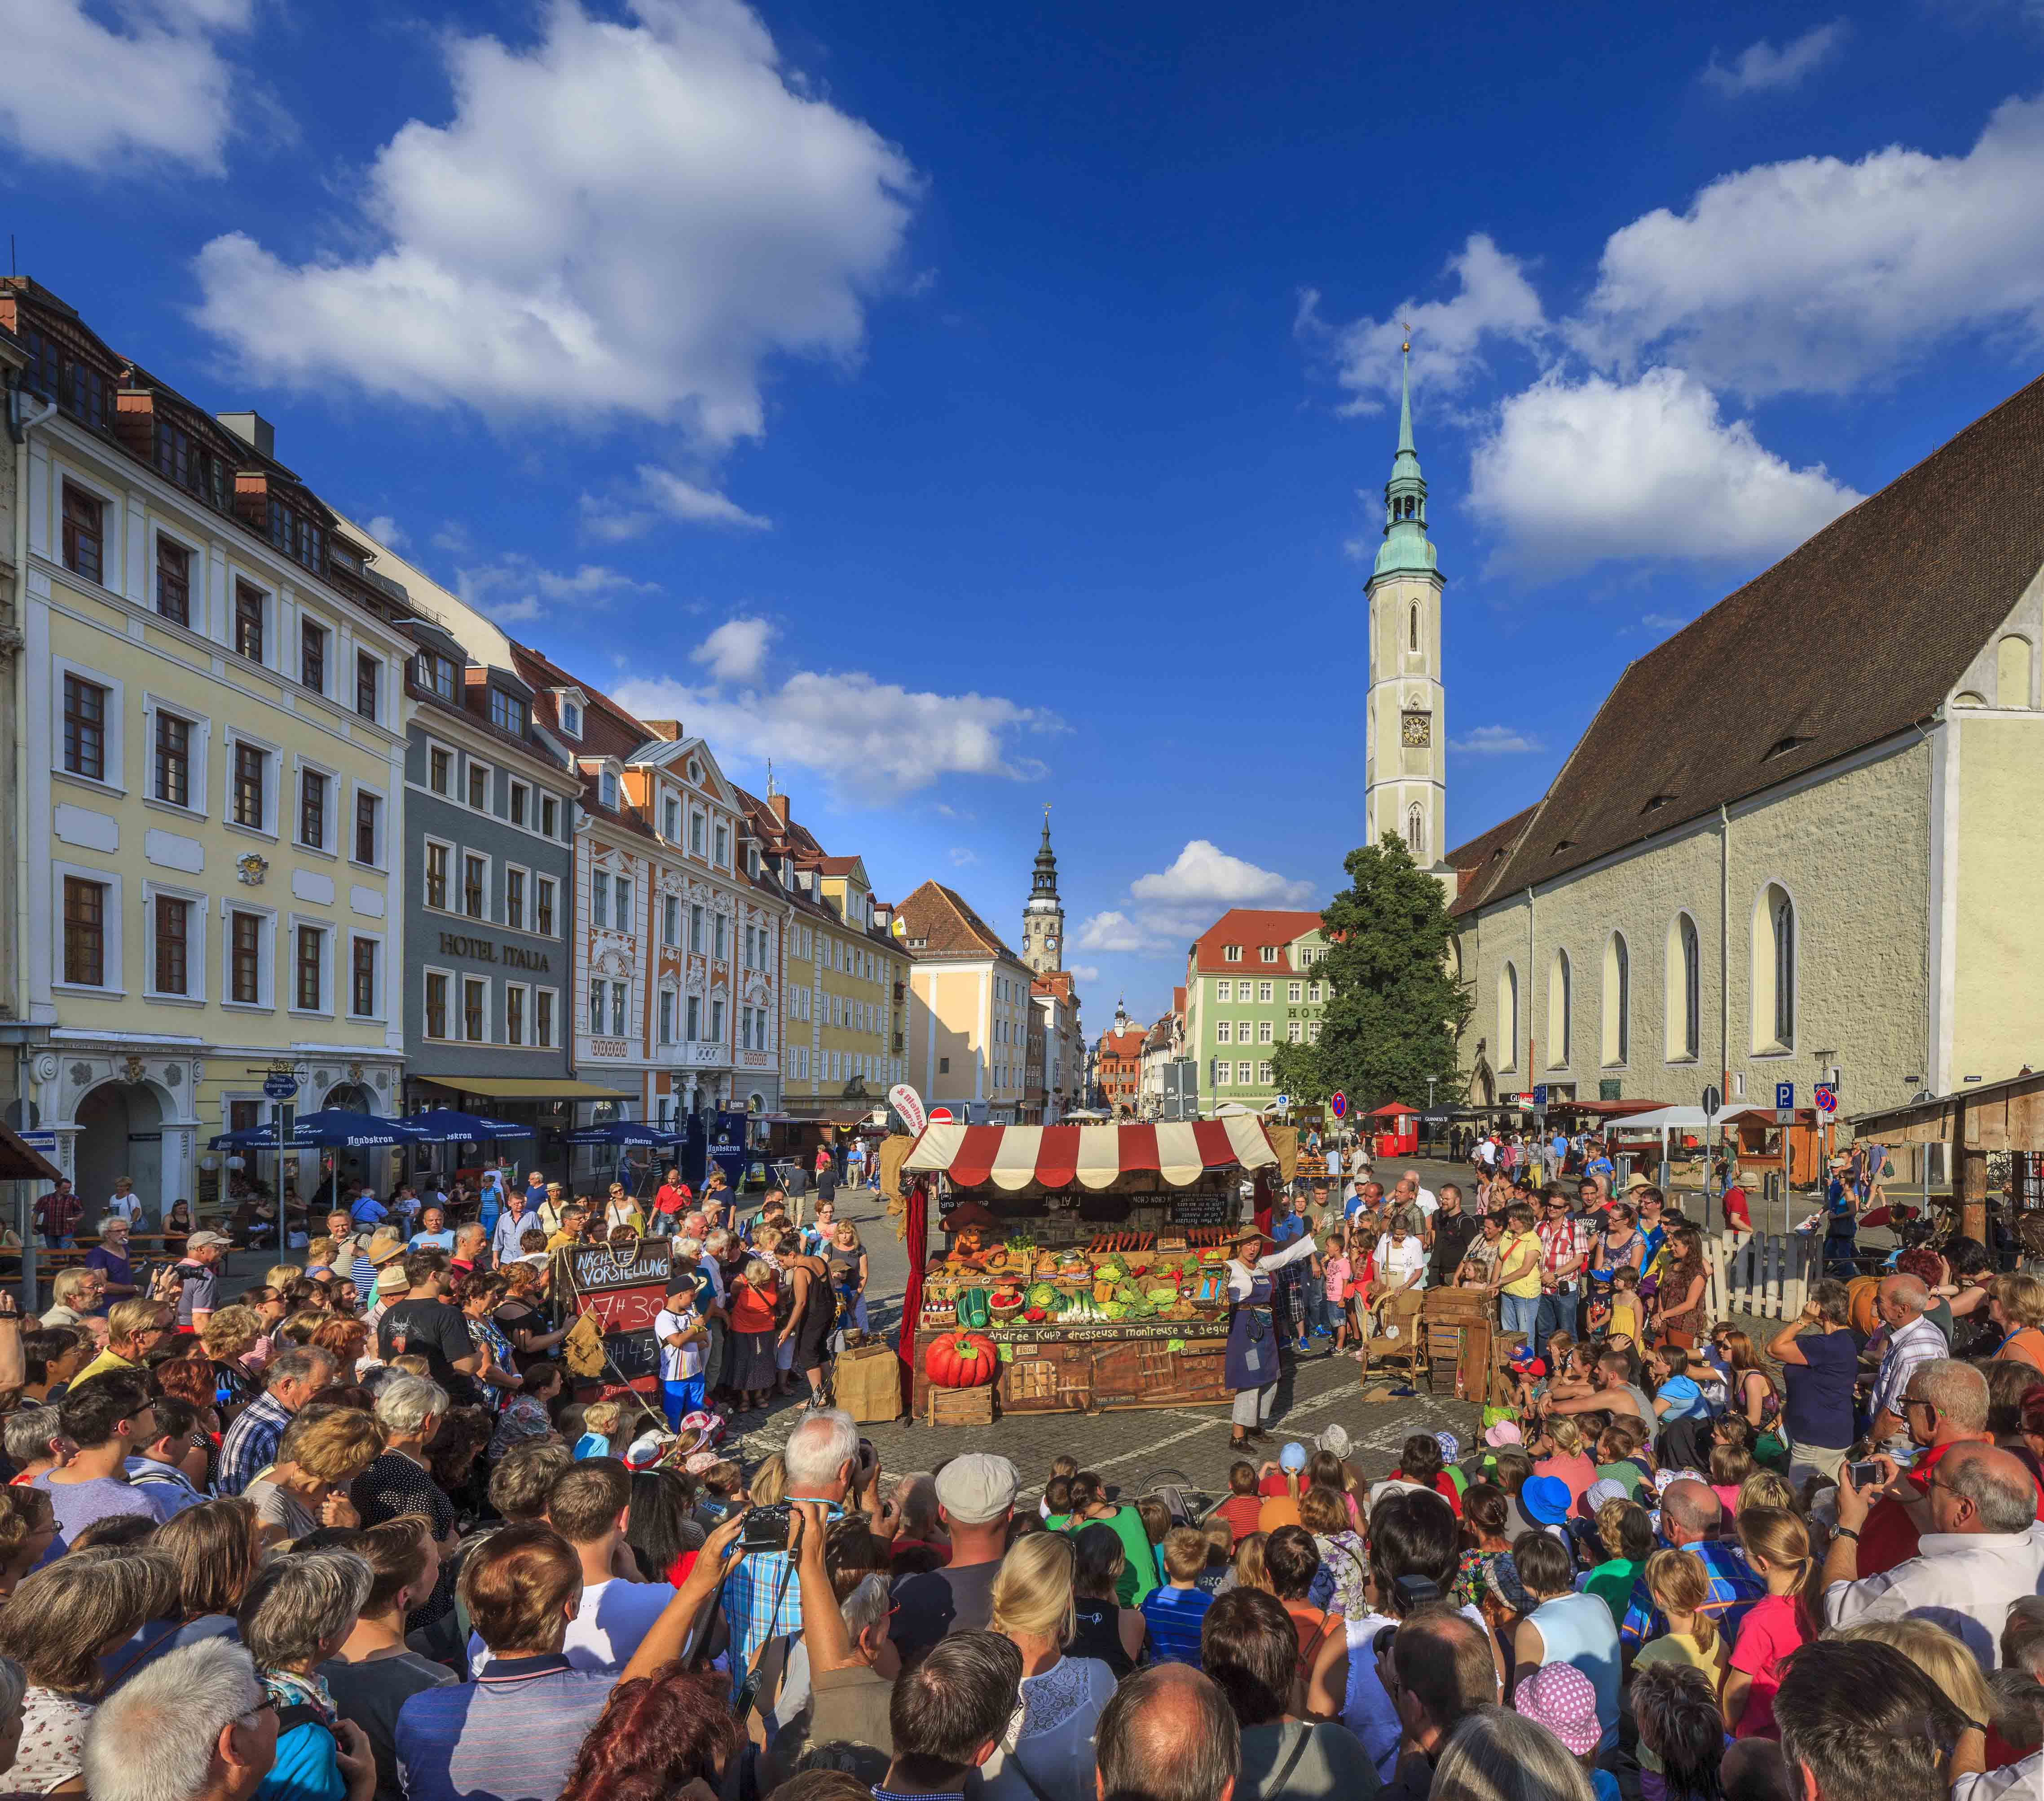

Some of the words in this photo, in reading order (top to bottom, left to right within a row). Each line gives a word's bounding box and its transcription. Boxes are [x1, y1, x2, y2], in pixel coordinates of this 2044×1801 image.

[439, 931, 497, 962] HOTEL
[503, 945, 550, 972] ITALIA
[1287, 1008, 1321, 1018] HOT
[1511, 1094, 1520, 1102] GU
[1780, 1086, 1789, 1105] P
[988, 1329, 1029, 1342] Andrée
[1035, 1330, 1060, 1342] Kupp
[1068, 1328, 1119, 1340] dresseuse
[1126, 1326, 1179, 1337] montreuse
[1184, 1325, 1194, 1336] de
